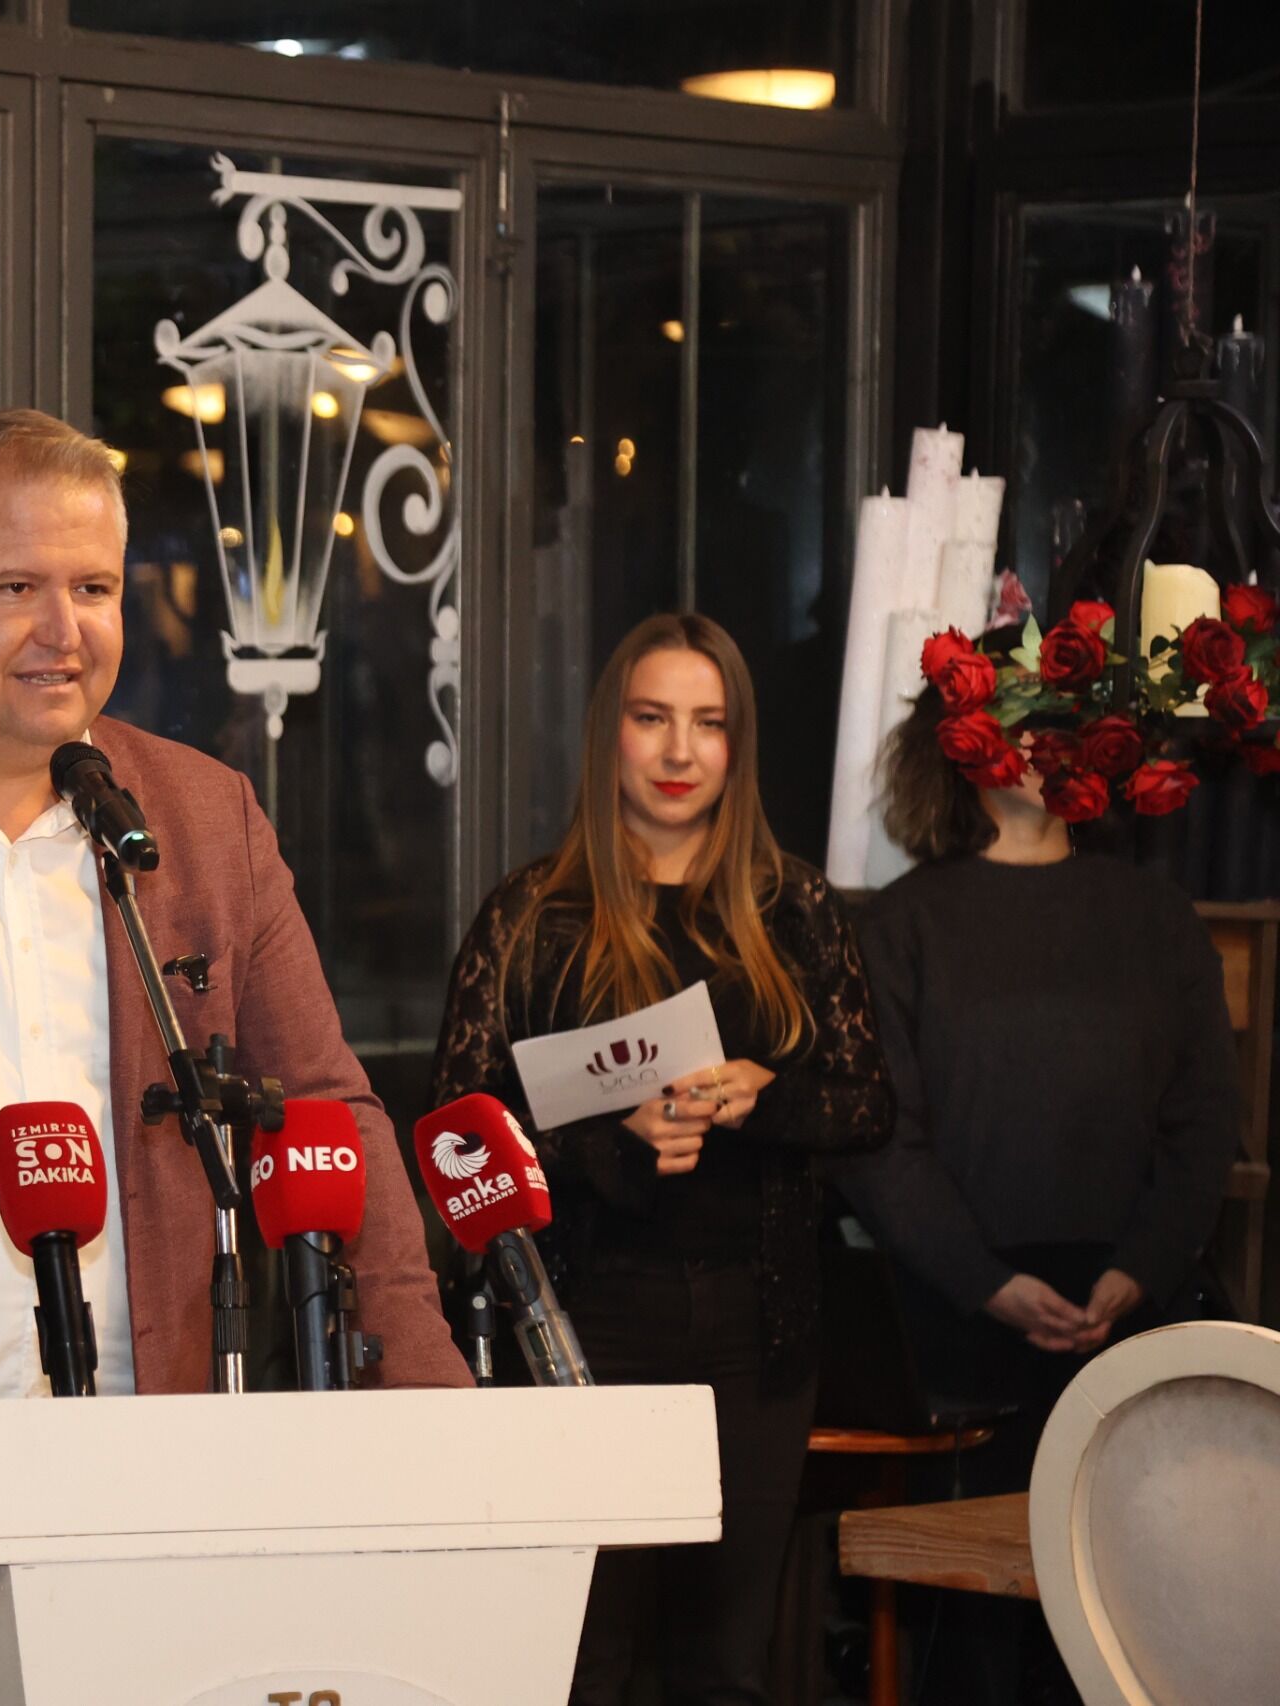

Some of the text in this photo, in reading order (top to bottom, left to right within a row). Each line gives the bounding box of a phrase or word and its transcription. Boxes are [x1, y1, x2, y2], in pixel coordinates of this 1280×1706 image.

[287, 1146, 357, 1172] NEO
[447, 1172, 515, 1214] anka
[452, 1201, 482, 1221] HABER
